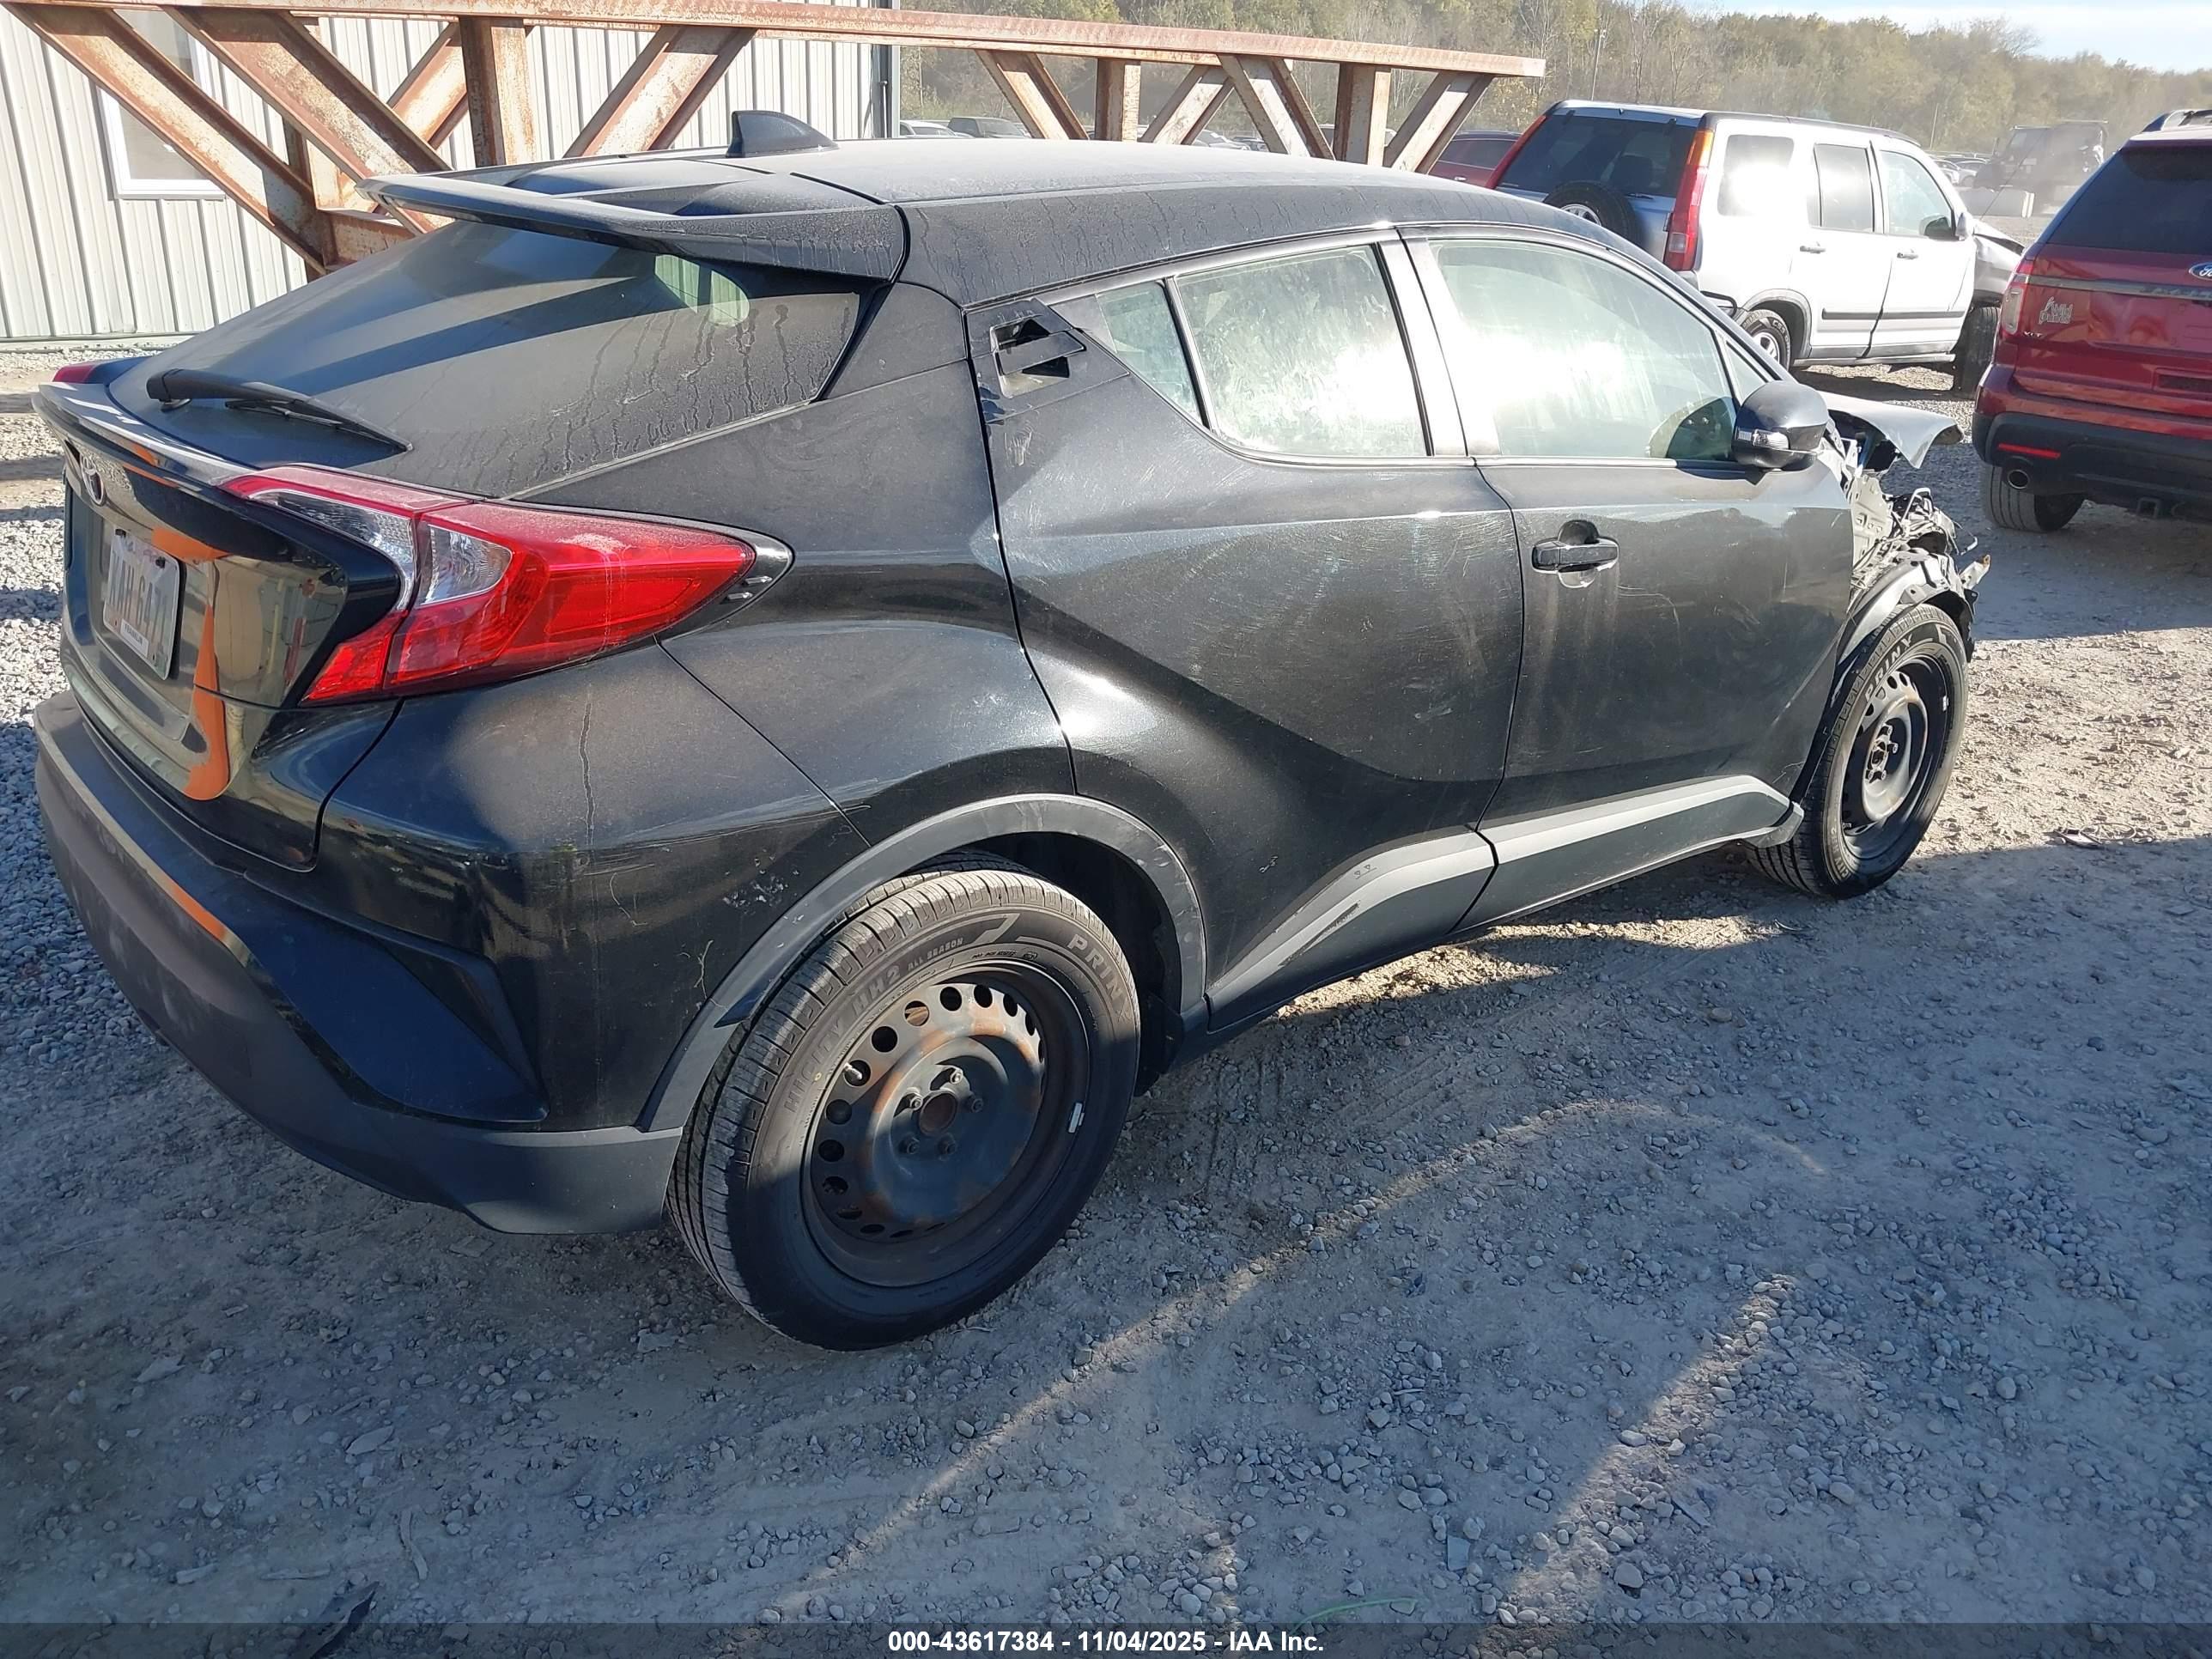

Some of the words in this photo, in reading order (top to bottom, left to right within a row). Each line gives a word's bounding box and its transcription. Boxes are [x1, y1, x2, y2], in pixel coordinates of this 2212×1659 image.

[907, 956, 924, 972] ALL
[927, 937, 964, 961] SEASON
[1067, 933, 1133, 1024] PRINX
